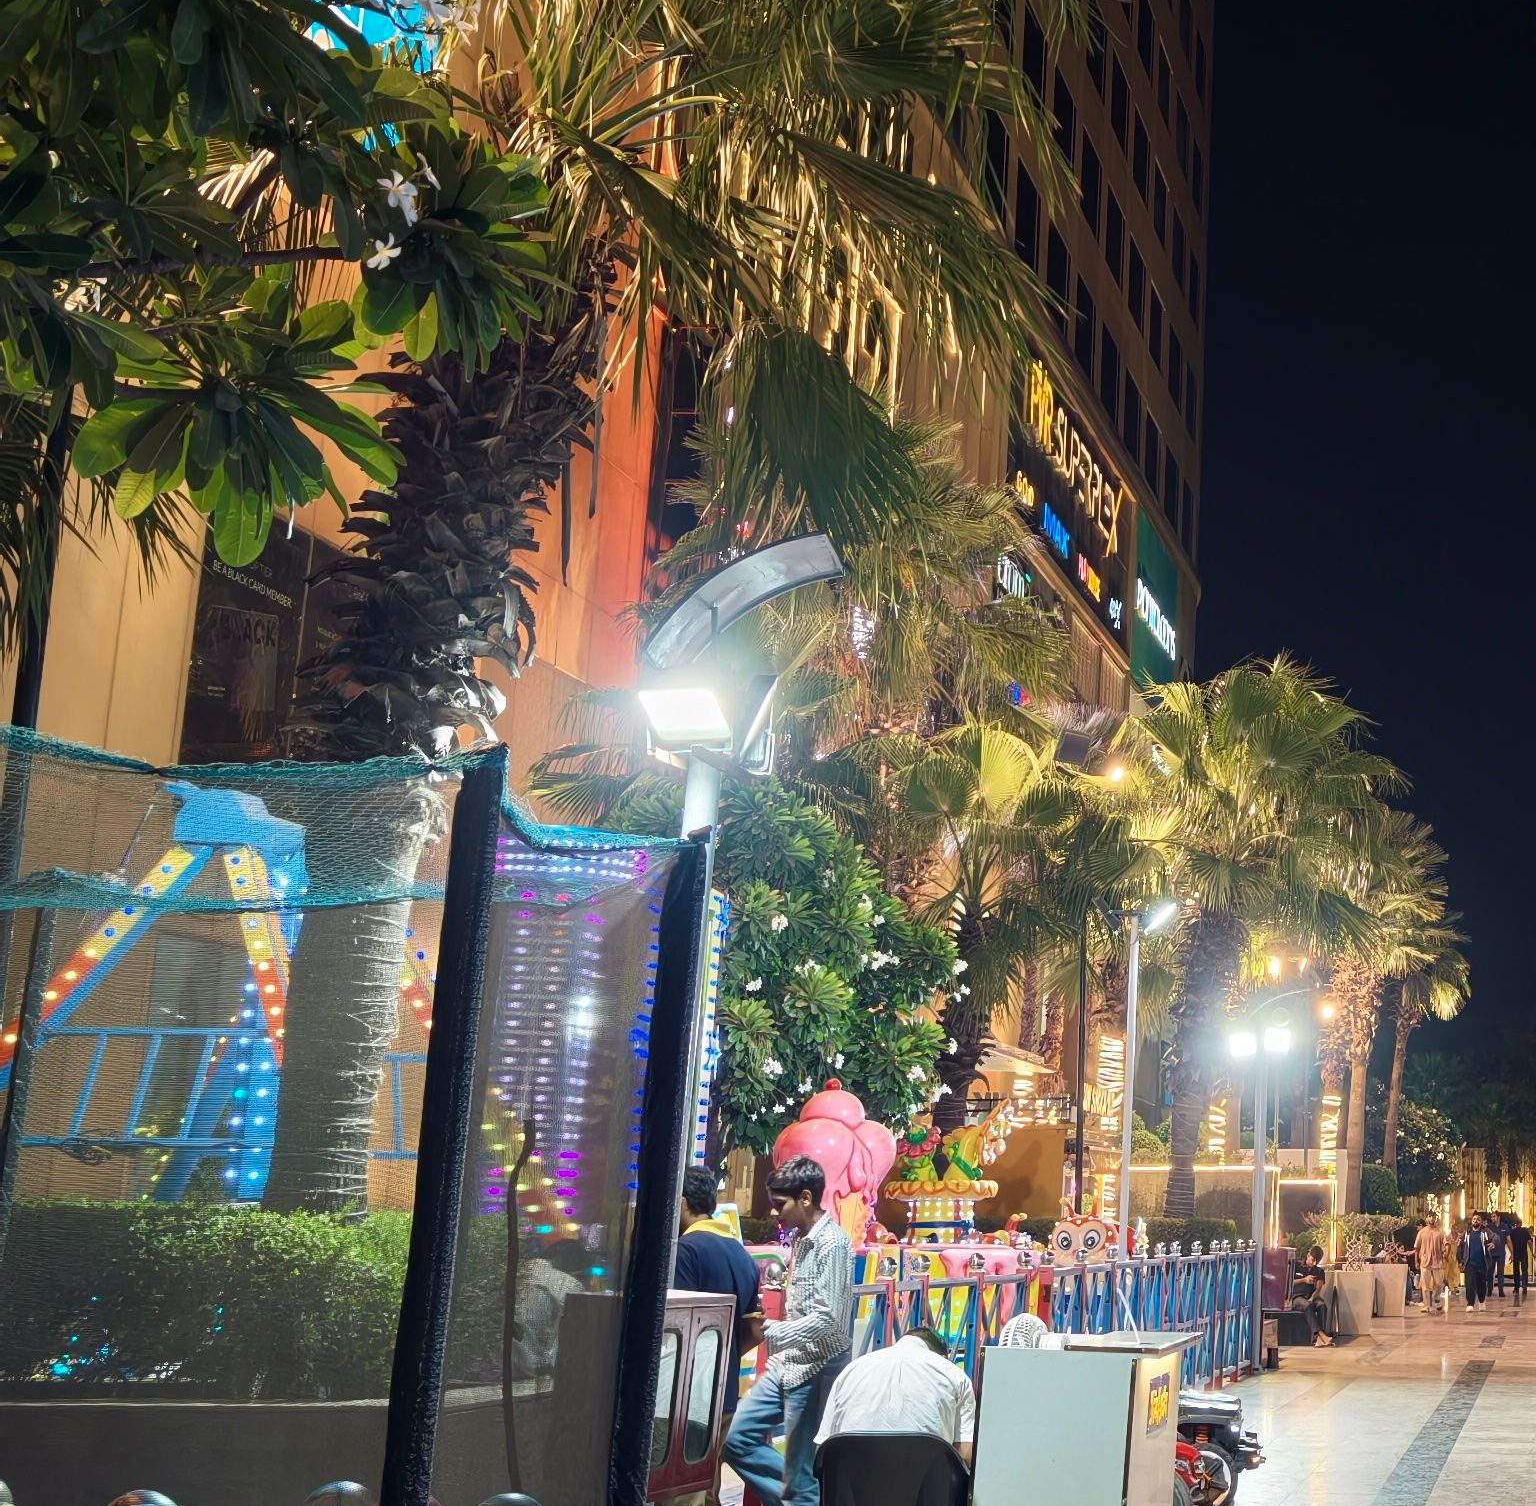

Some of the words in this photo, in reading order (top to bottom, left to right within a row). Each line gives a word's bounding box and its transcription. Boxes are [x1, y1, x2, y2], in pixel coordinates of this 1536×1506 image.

[1055, 406, 1123, 558] SUPERPLEX
[1043, 502, 1070, 560] IMAX
[248, 579, 266, 595] CARD
